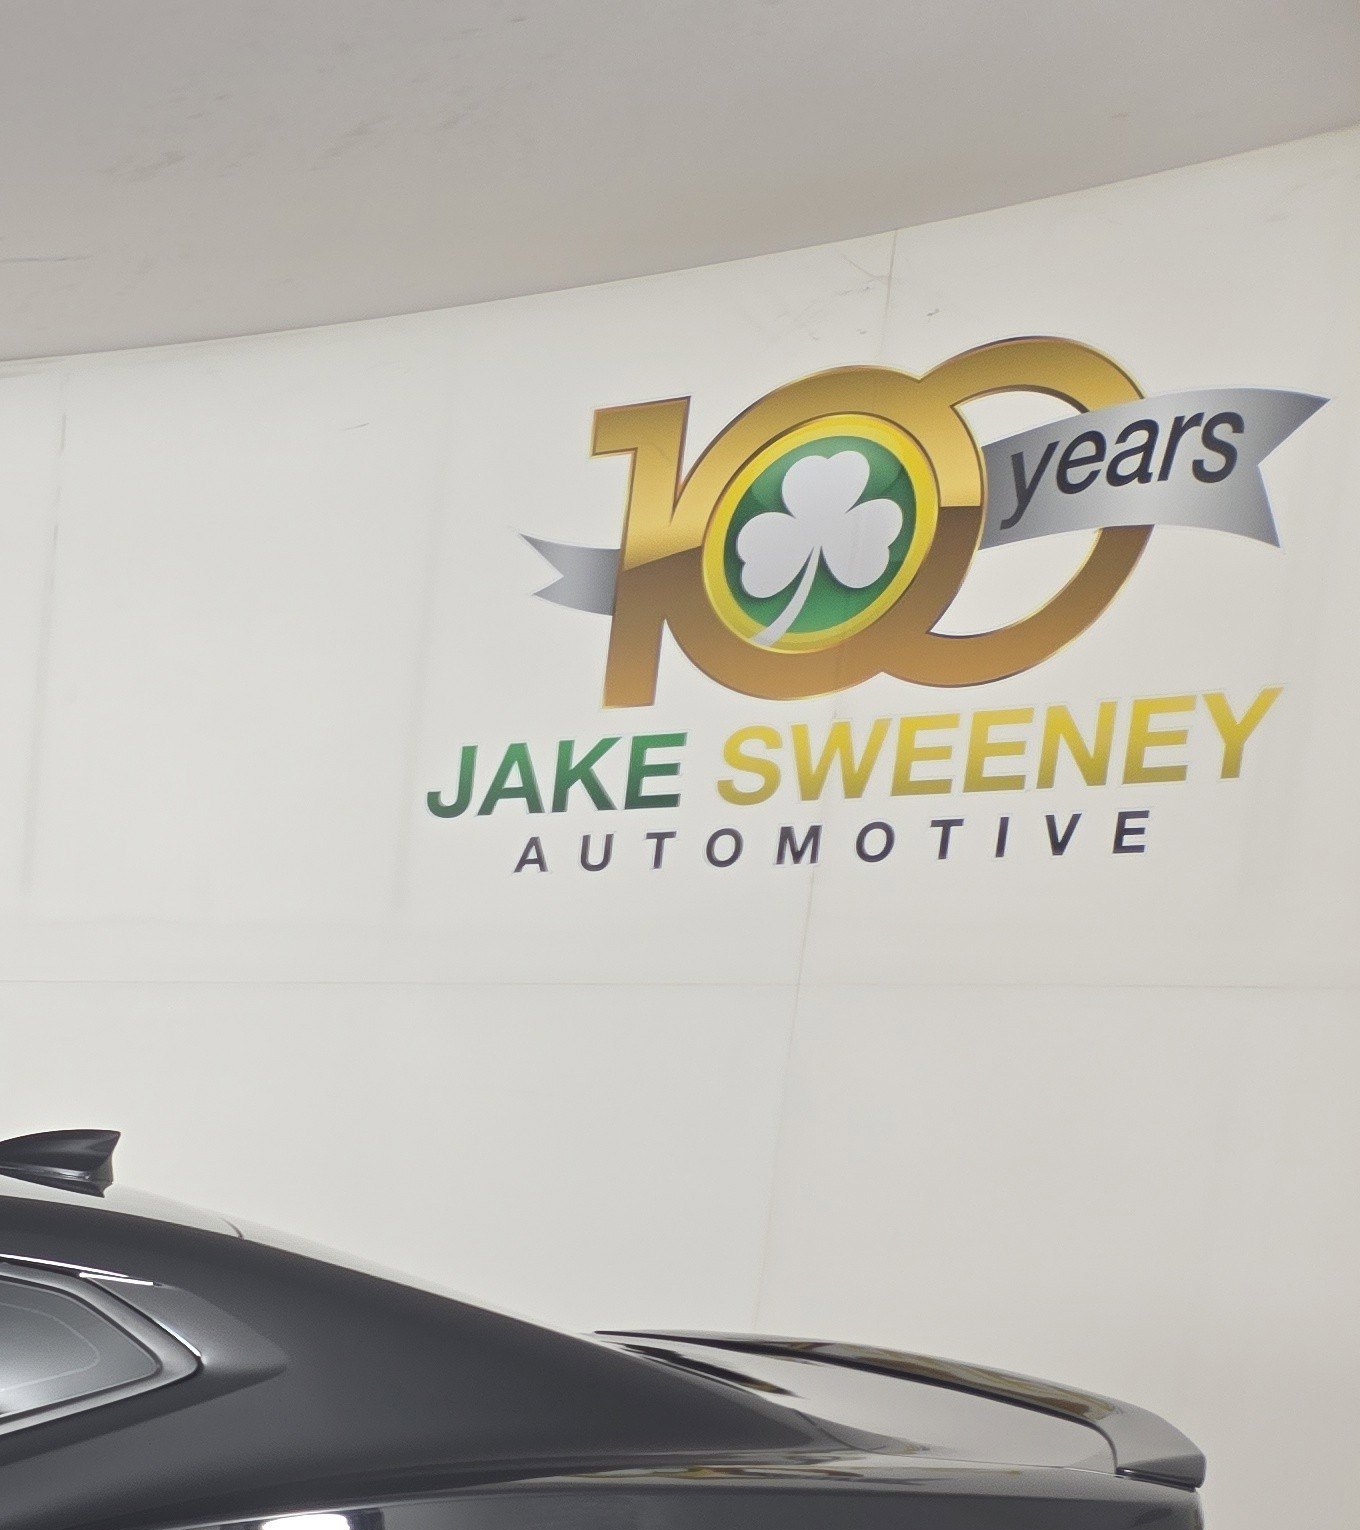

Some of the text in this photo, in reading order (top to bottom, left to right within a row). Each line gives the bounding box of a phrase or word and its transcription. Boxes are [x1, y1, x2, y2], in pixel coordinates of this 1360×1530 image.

[590, 335, 1245, 710] 100 years
[426, 686, 1285, 819] JAKE SWEENEY
[514, 810, 1151, 874] AUTOMOTIVE
